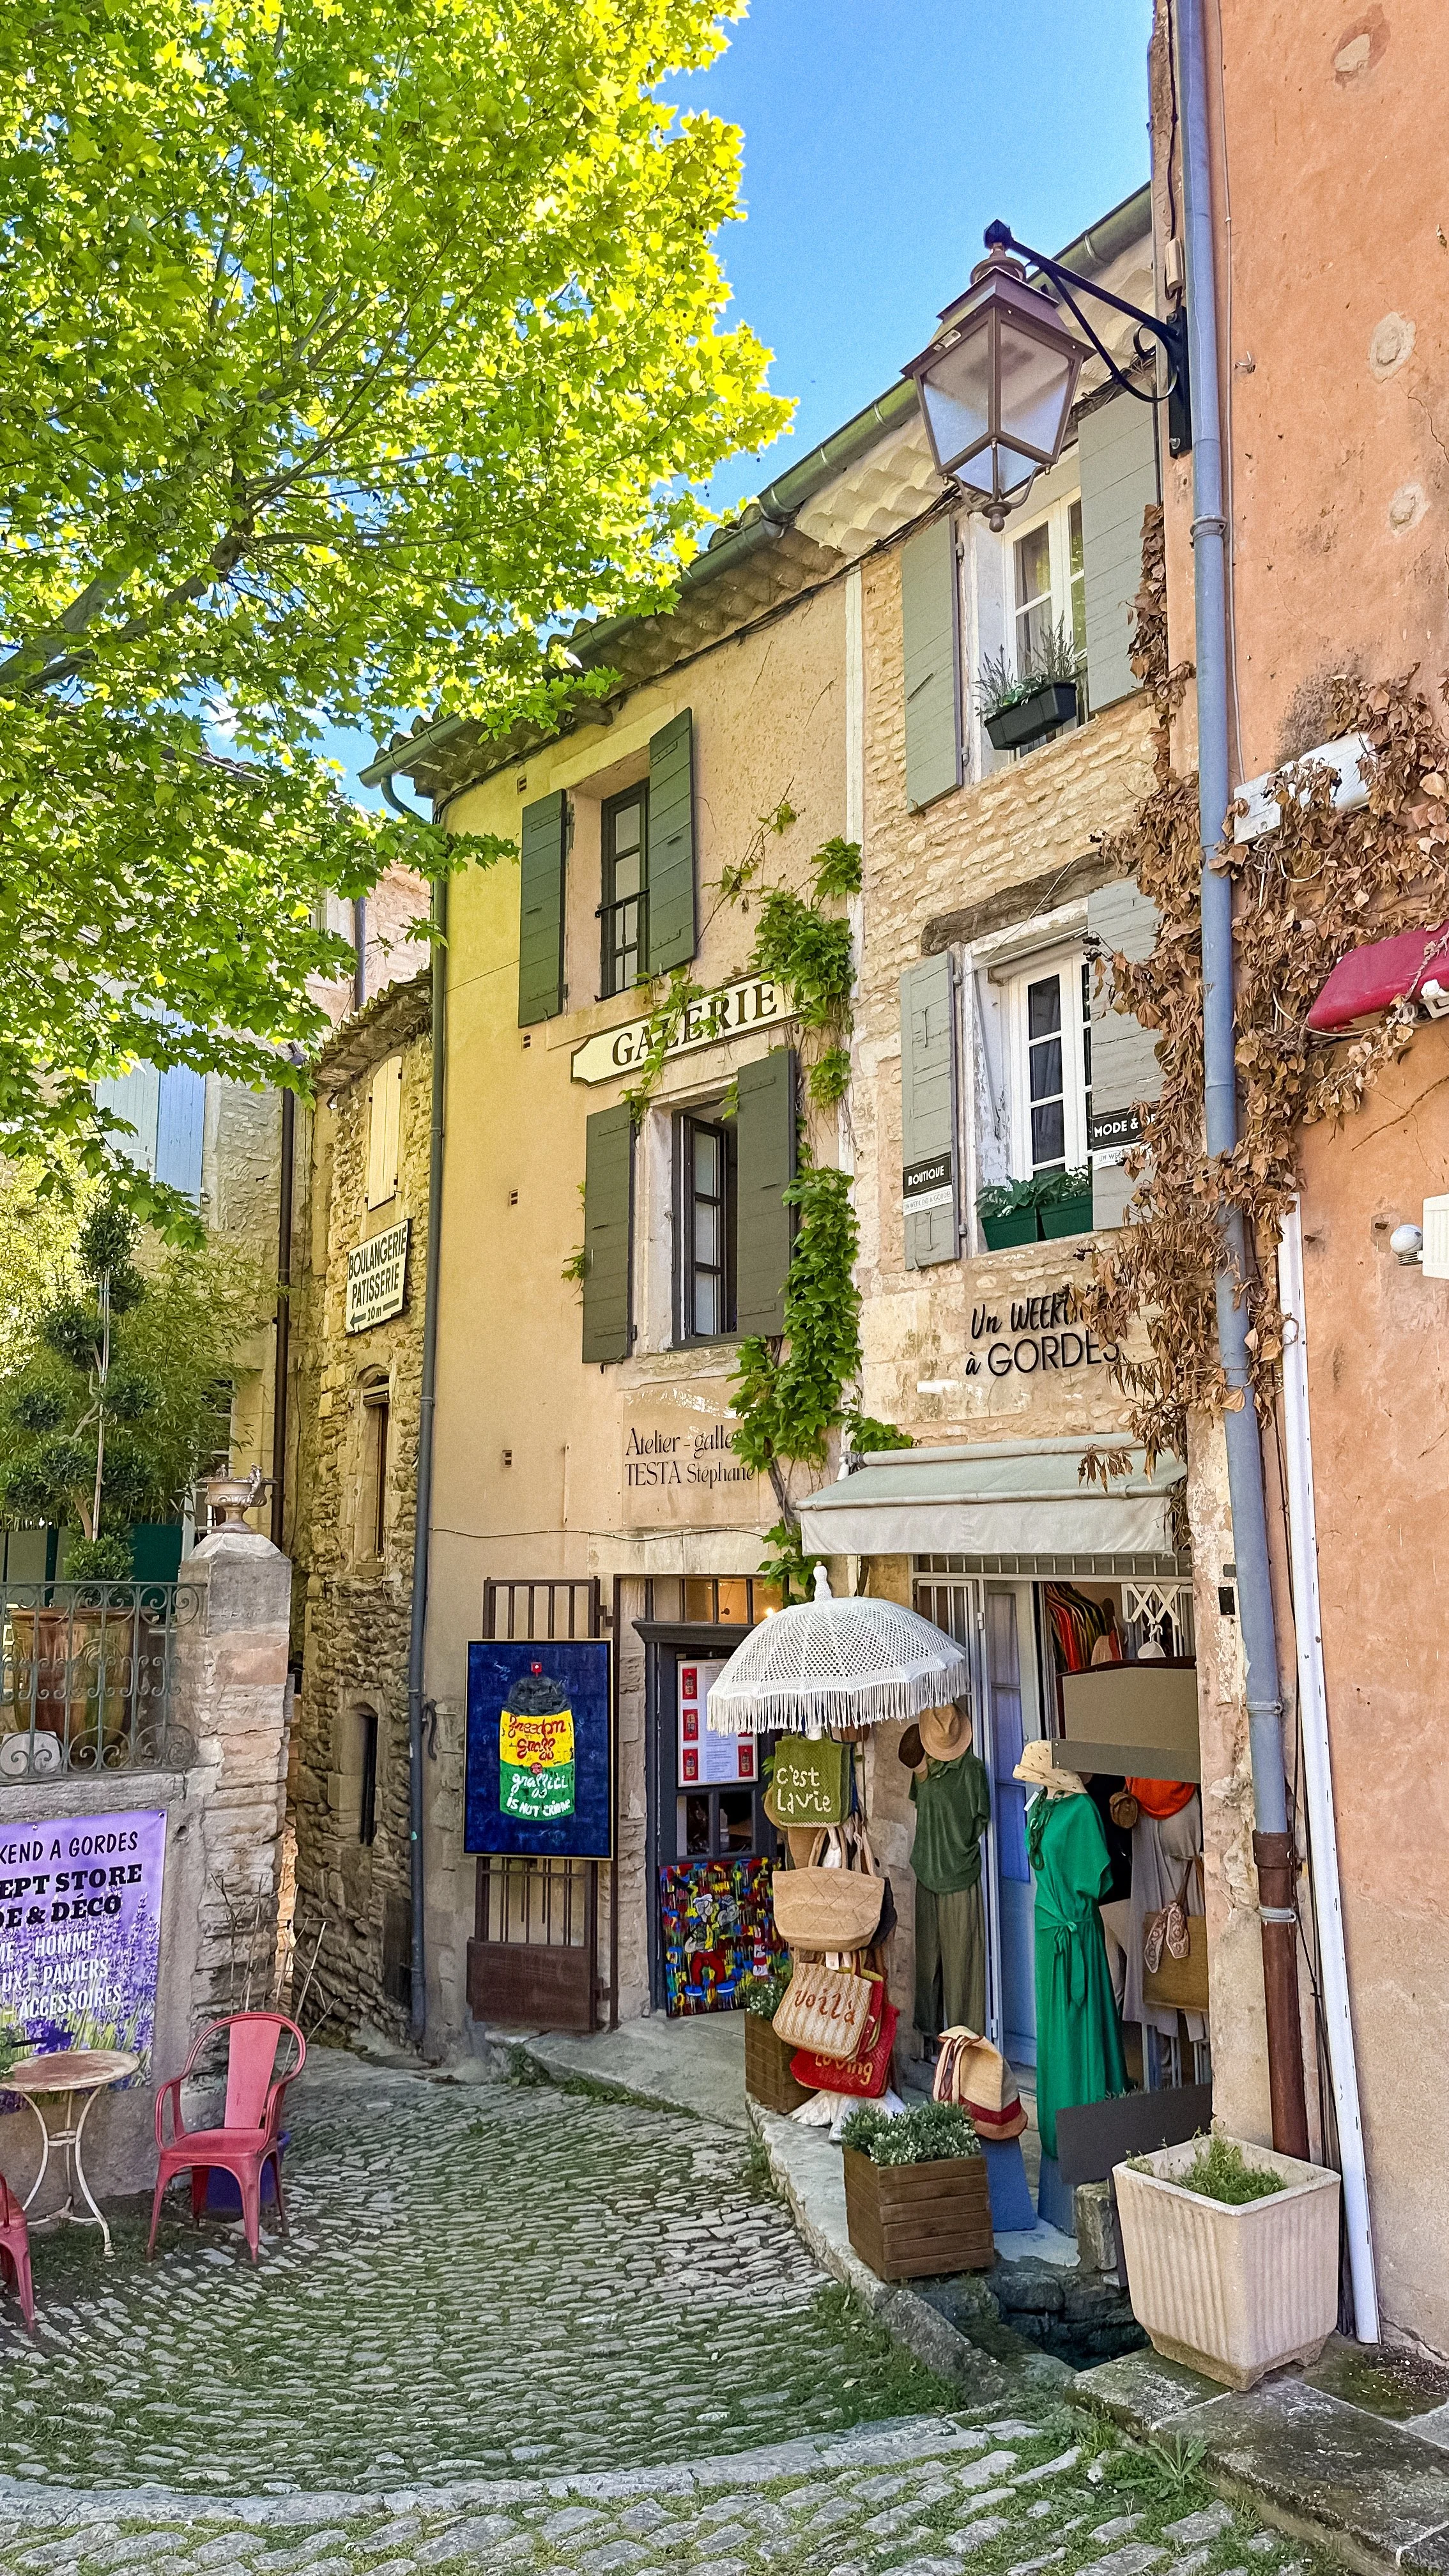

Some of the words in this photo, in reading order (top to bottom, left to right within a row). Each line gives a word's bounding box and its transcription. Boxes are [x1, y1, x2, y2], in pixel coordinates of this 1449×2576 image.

[611, 979, 778, 1066] GALERIE
[1094, 1119, 1128, 1138] MODE
[1130, 1117, 1138, 1130] &
[908, 1165, 944, 1186] BOUTIQUE
[348, 1224, 407, 1281] BOULANGERIE
[351, 1262, 400, 1309] PATISSERIE
[971, 1303, 1002, 1340] Un
[1011, 1291, 1084, 1332] WEEK
[965, 1351, 981, 1376] à
[988, 1330, 1119, 1377] GORDES
[625, 1427, 680, 1455] Atelier
[693, 1424, 733, 1459] galle
[625, 1460, 682, 1486] TESTA
[687, 1461, 755, 1489] Stéphane
[50, 1839, 61, 1861] A
[69, 1830, 139, 1857] GORDES
[55, 1864, 142, 1892] STORE
[26, 1906, 46, 1925] &
[50, 1892, 121, 1922] DÉCO
[34, 1929, 96, 1958] HOMME
[43, 1957, 109, 1986] PANIERS
[19, 1984, 122, 2020] ACCESSOIRES
